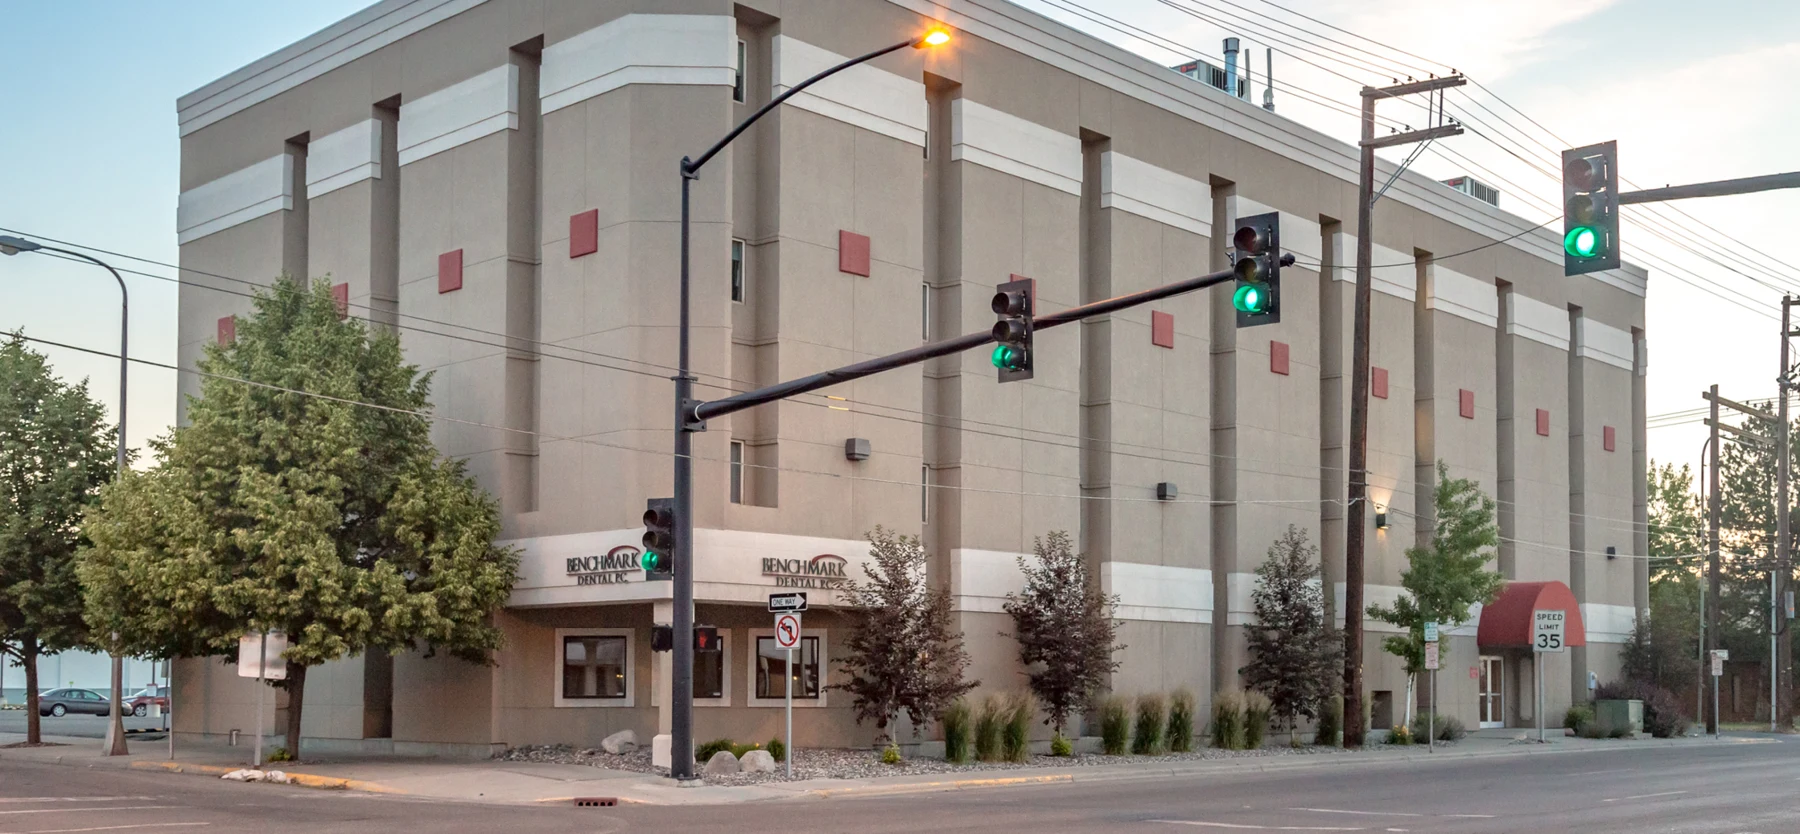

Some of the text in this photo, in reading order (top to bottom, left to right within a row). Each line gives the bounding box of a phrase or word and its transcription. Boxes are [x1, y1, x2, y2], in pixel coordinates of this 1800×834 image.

[566, 553, 641, 573] BENCHMARK
[762, 558, 847, 577] BENCHMARK
[577, 574, 613, 586] DENTAL
[776, 577, 818, 588] DENTAL
[1537, 613, 1563, 621] SPEED
[1538, 634, 1561, 649] 35
